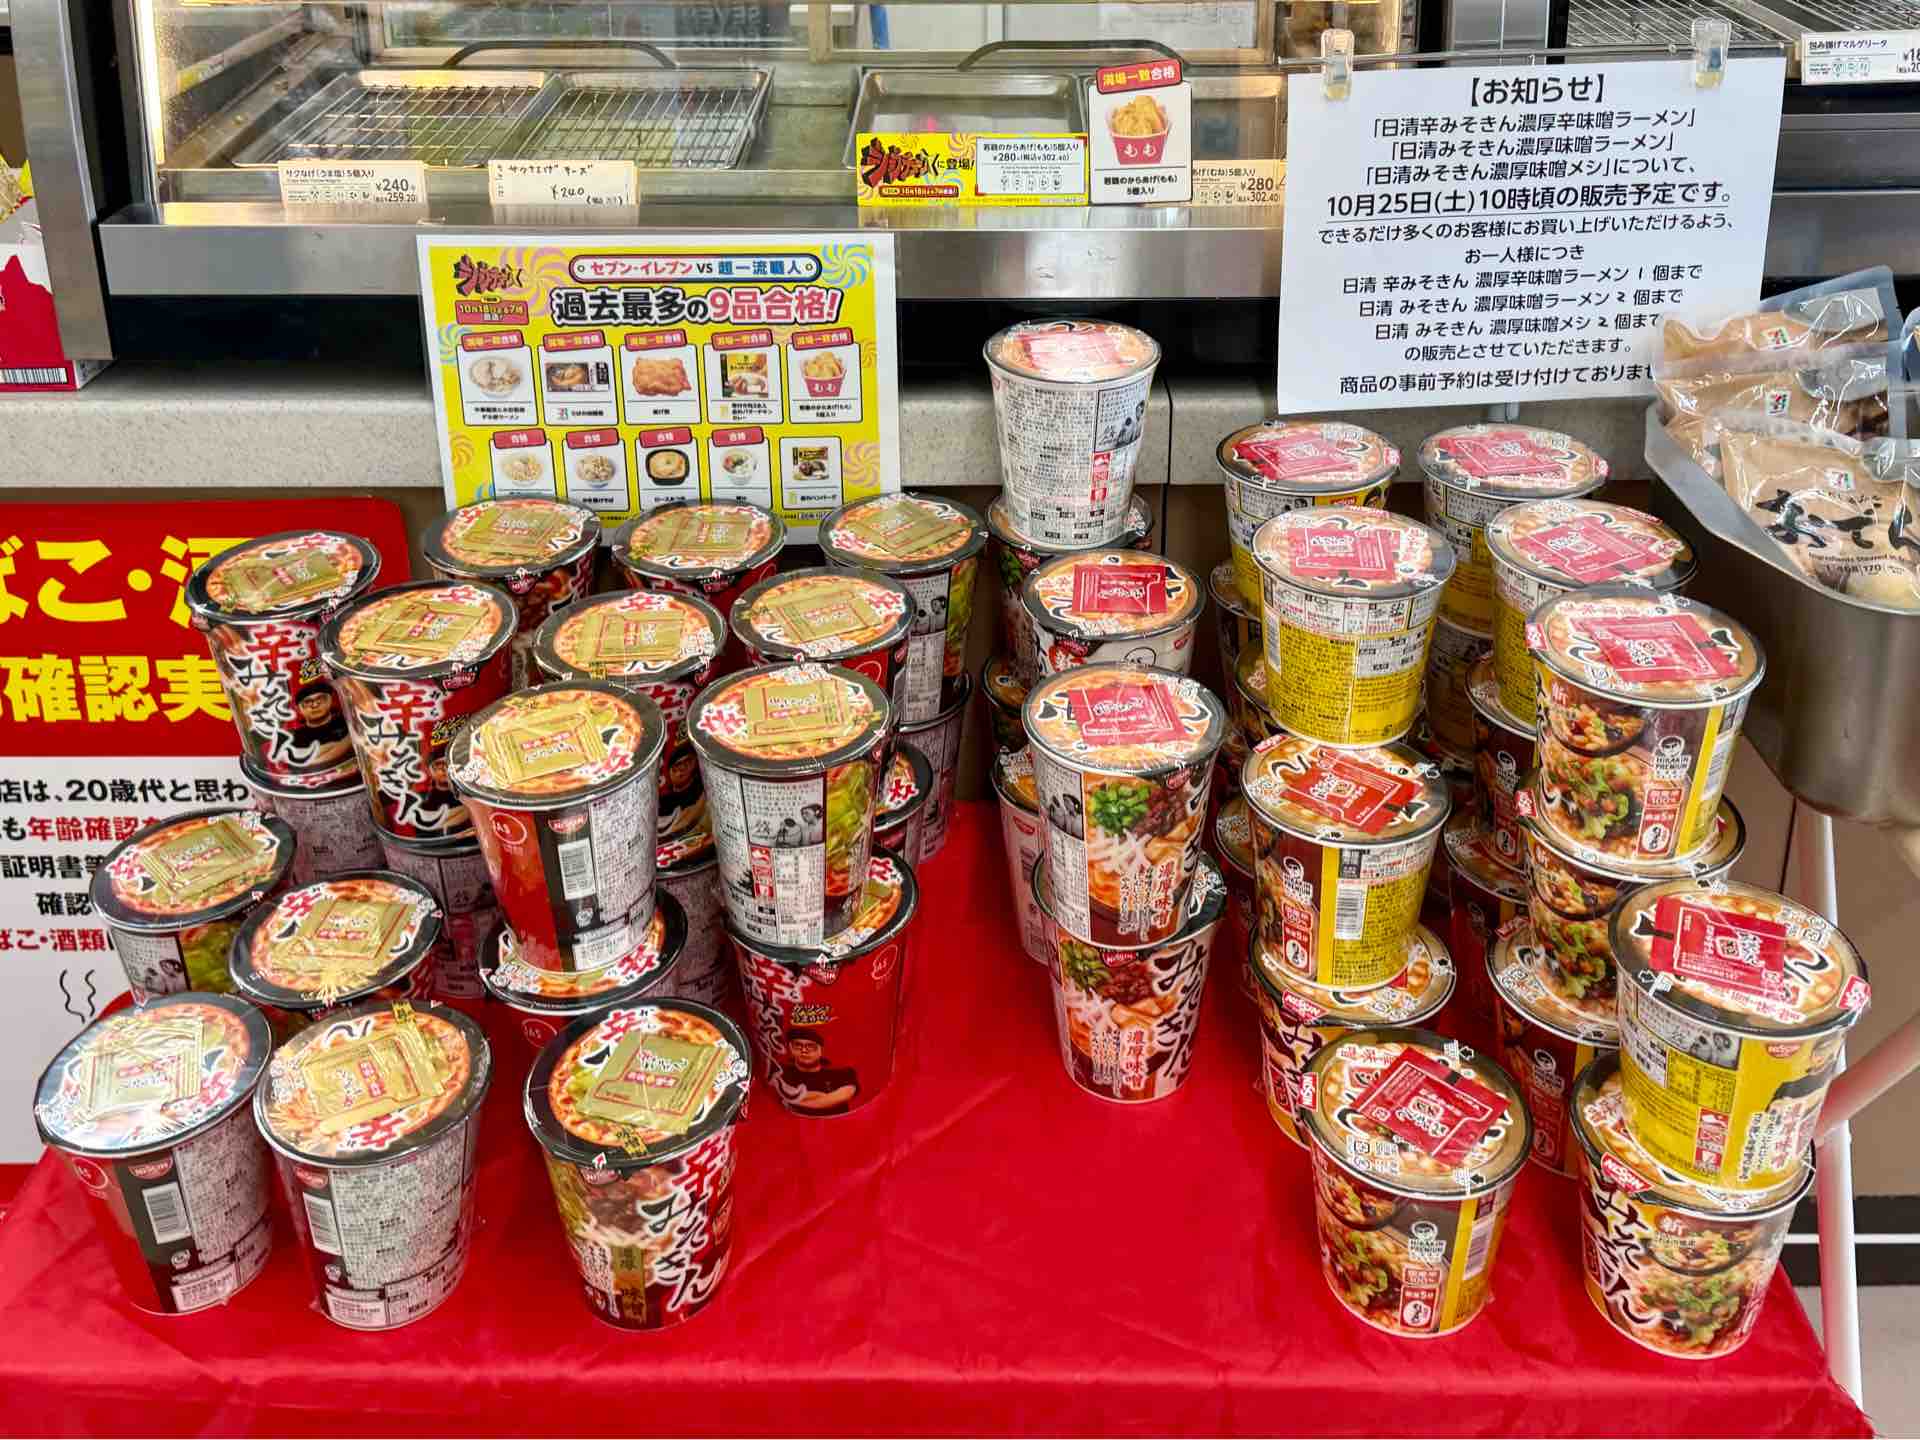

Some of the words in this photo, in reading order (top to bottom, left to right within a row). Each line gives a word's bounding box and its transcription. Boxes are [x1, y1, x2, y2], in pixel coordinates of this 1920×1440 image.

[1469, 74, 1606, 108] 【お知らせ】
[1373, 109, 1697, 138] 「日清辛みそきん濃厚辛味噌ラーメン」
[1391, 132, 1677, 161] 「日清みそきん濃厚味噌ラーメン」
[1365, 158, 1698, 186] 「日清みそきん濃厚味噌メシ」について、
[1326, 181, 1733, 219] 10月25日(土)10時頃の販売予定です。
[1318, 212, 1735, 246] できるだけ多くのお客様にお買い上げいただけるよう、
[696, 262, 713, 274] VS
[717, 259, 801, 276] 超一流職人
[1464, 243, 1586, 264] お一人様につき
[1342, 276, 1377, 294] 日清
[1382, 272, 1470, 292] 辛みそきん
[1474, 266, 1630, 289] 濃厚辛味噌ラーメン
[1652, 263, 1704, 281] 個まで
[553, 287, 837, 324] 過去最多の9品合格!
[1359, 299, 1394, 318] 日清
[1399, 295, 1469, 315] みそきん
[1473, 290, 1611, 312] 濃厚味噌ラーメン
[1616, 290, 1627, 304] 2
[1633, 287, 1685, 306] 個まで
[1374, 322, 1410, 341] 日清
[1416, 318, 1484, 338] みそきん
[1489, 314, 1592, 335] 濃厚味噌メシ
[1597, 315, 1609, 328] 2
[1404, 337, 1634, 362] の販売とさせていただきます。
[0, 816, 160, 842] も年齢確認
[1603, 1158, 1645, 1191] NISSIN
[1660, 1215, 1684, 1237] 新
